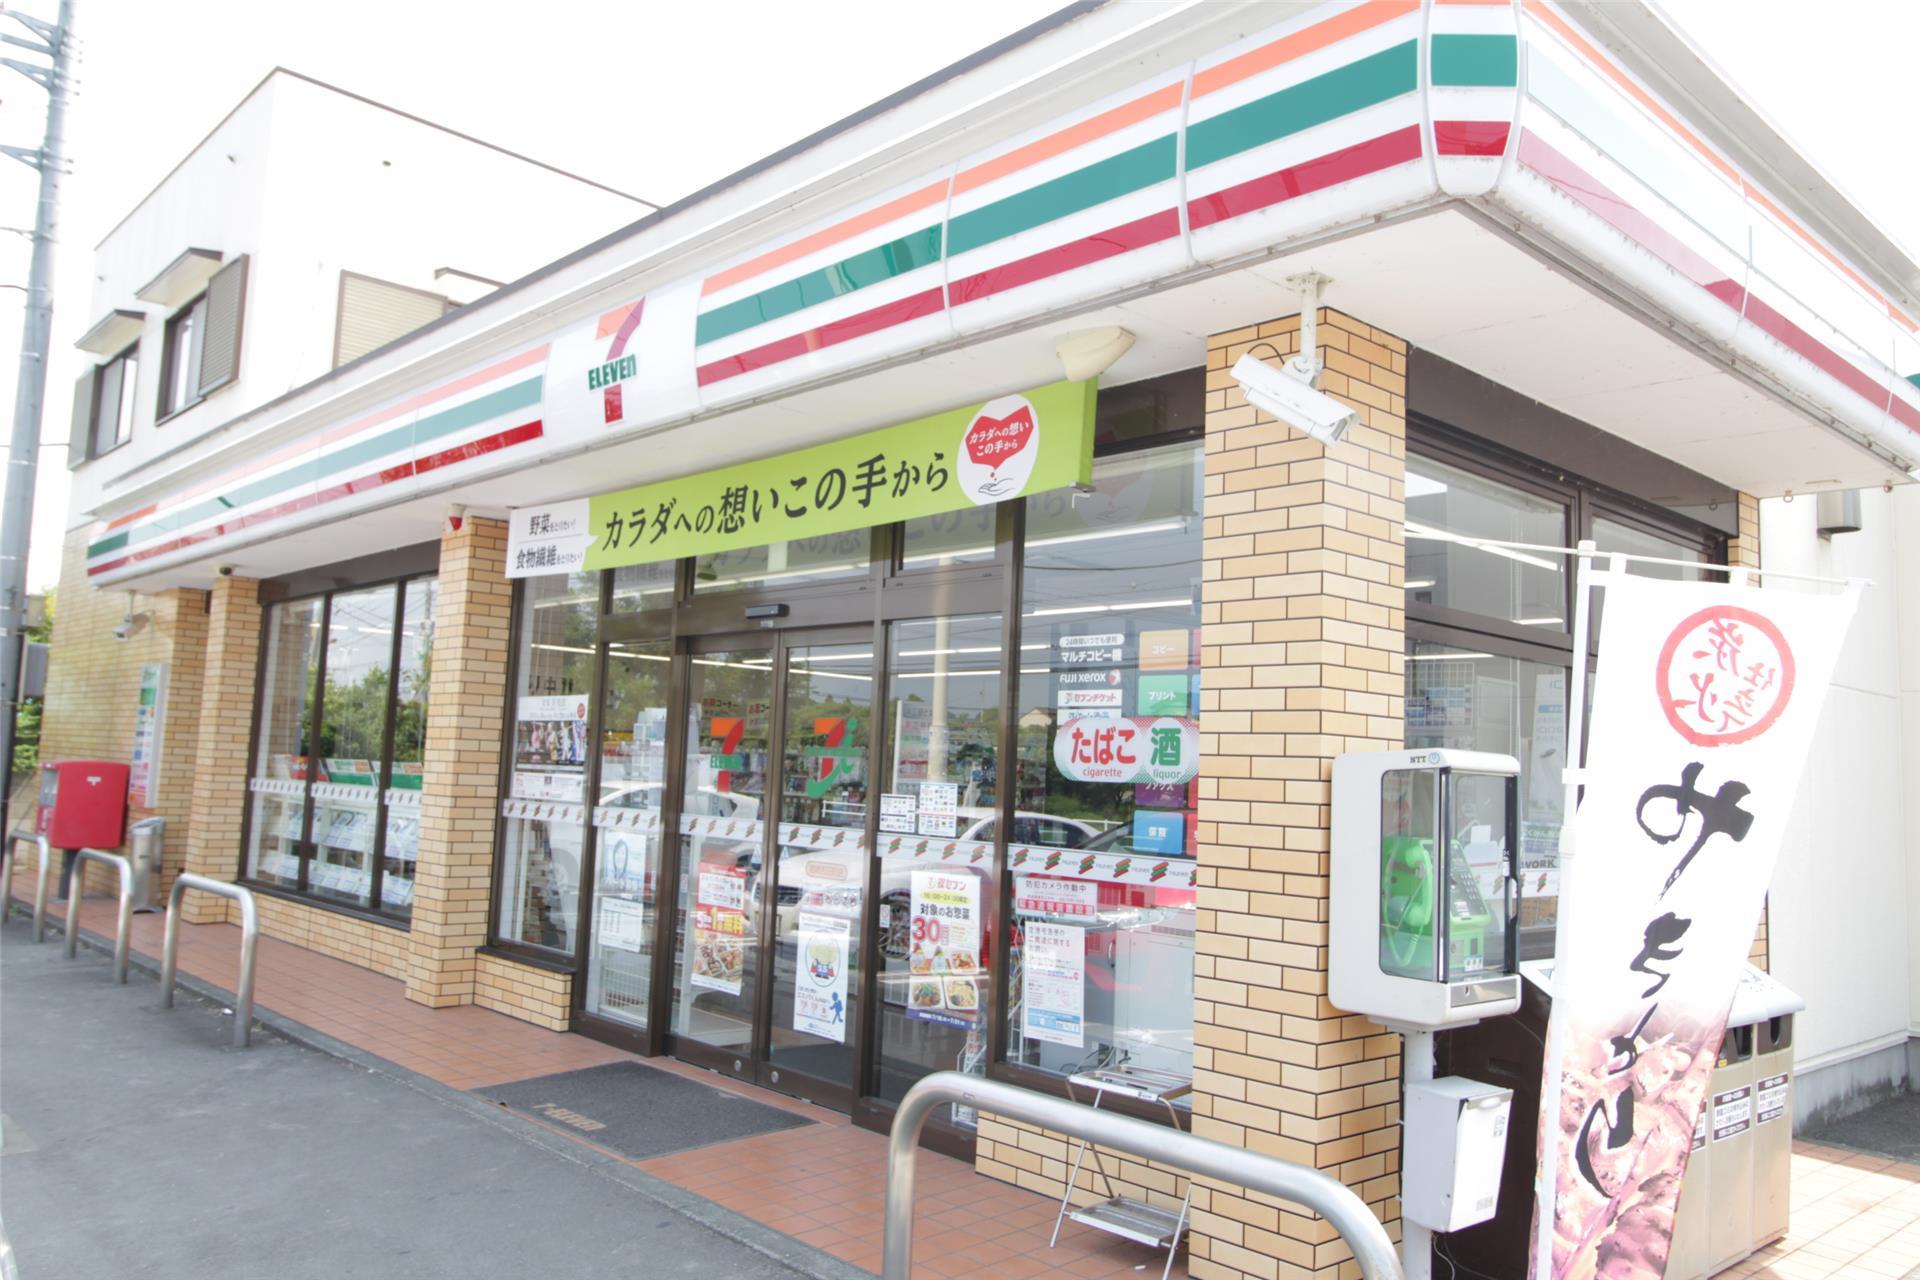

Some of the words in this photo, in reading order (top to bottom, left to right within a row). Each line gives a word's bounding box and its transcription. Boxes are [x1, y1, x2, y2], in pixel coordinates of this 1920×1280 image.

[969, 421, 1030, 445] カラダへの想い
[976, 439, 1019, 457] この手から
[602, 451, 949, 551] カラダへの想いこの手から
[1060, 673, 1077, 684] FUJI
[1078, 671, 1106, 683] xerox
[1071, 726, 1136, 766] たばこ
[1150, 727, 1182, 766] 酒
[1410, 755, 1427, 763] NTT
[1082, 768, 1122, 778] cigarette
[1153, 769, 1181, 780] liquor
[912, 916, 942, 944] 30
